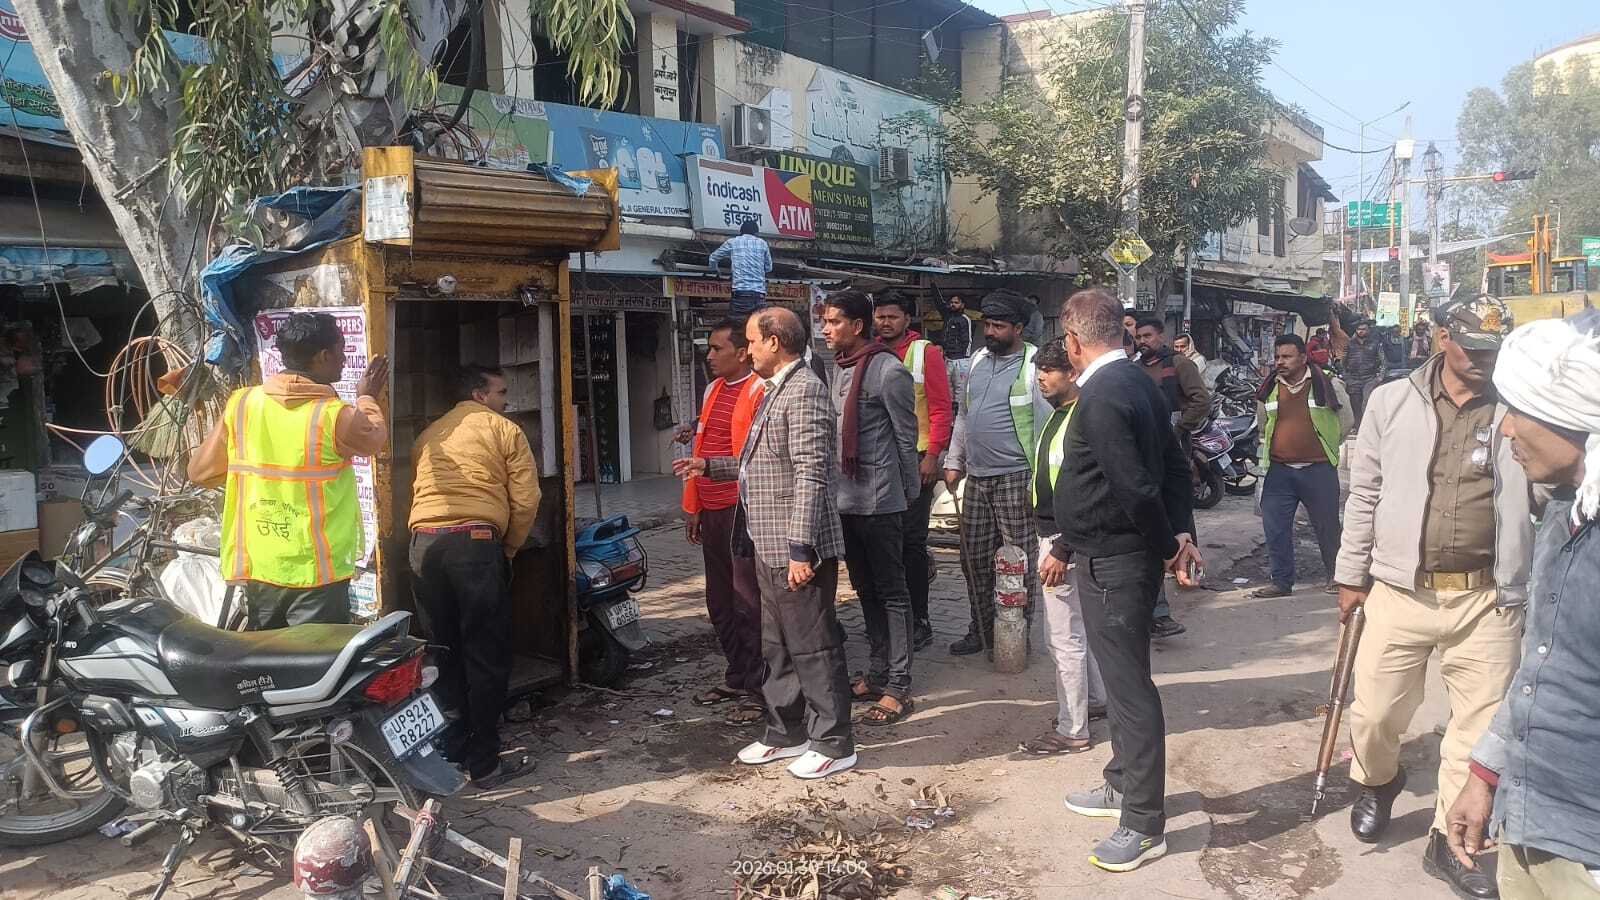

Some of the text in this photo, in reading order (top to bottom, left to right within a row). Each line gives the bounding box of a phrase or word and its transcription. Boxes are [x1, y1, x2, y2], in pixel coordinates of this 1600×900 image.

[706, 176, 761, 202] indicash
[843, 193, 868, 208] WEAR
[633, 206, 662, 214] GENERAL
[664, 207, 684, 215] STORE
[778, 204, 813, 232] ATM
[255, 516, 292, 542] उरई
[390, 700, 430, 733] UP92A
[400, 713, 435, 750] R8227
